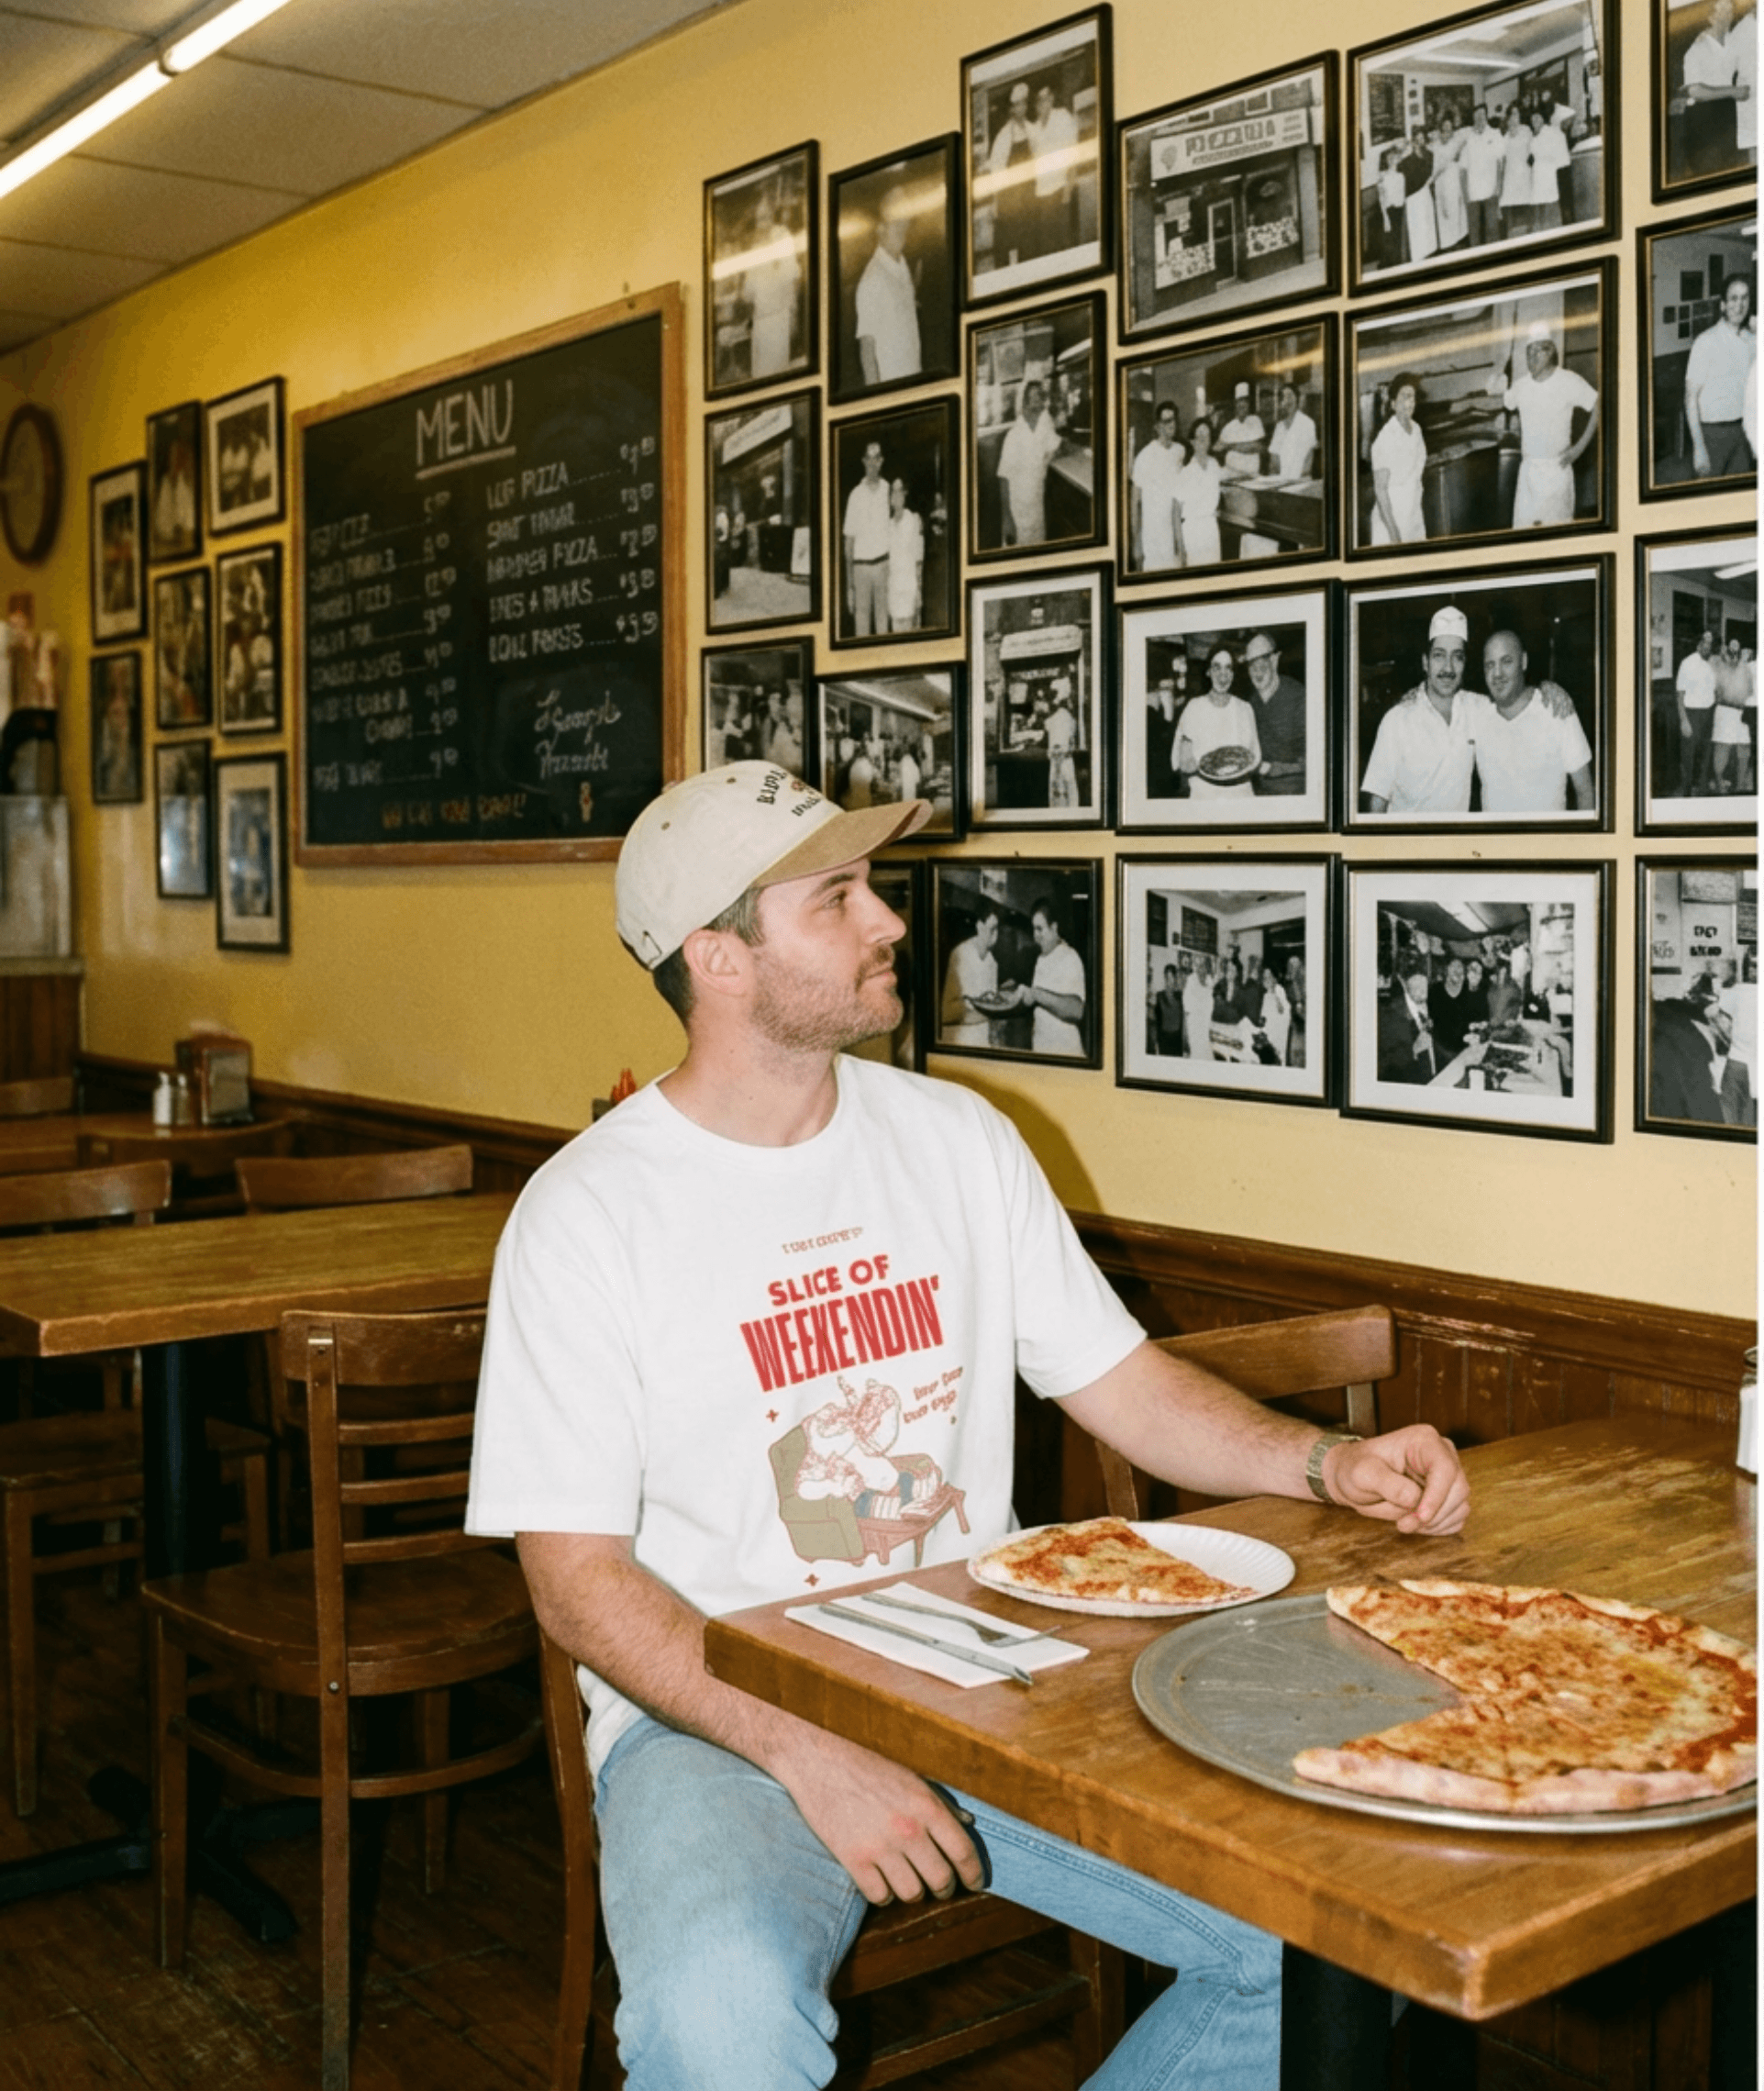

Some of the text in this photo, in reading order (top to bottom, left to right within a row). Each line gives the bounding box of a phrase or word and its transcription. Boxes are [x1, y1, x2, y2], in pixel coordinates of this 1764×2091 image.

[416, 379, 513, 466] MENU
[768, 1253, 889, 1307] SLICE OF
[739, 1274, 944, 1393] WEEKENDIN'
